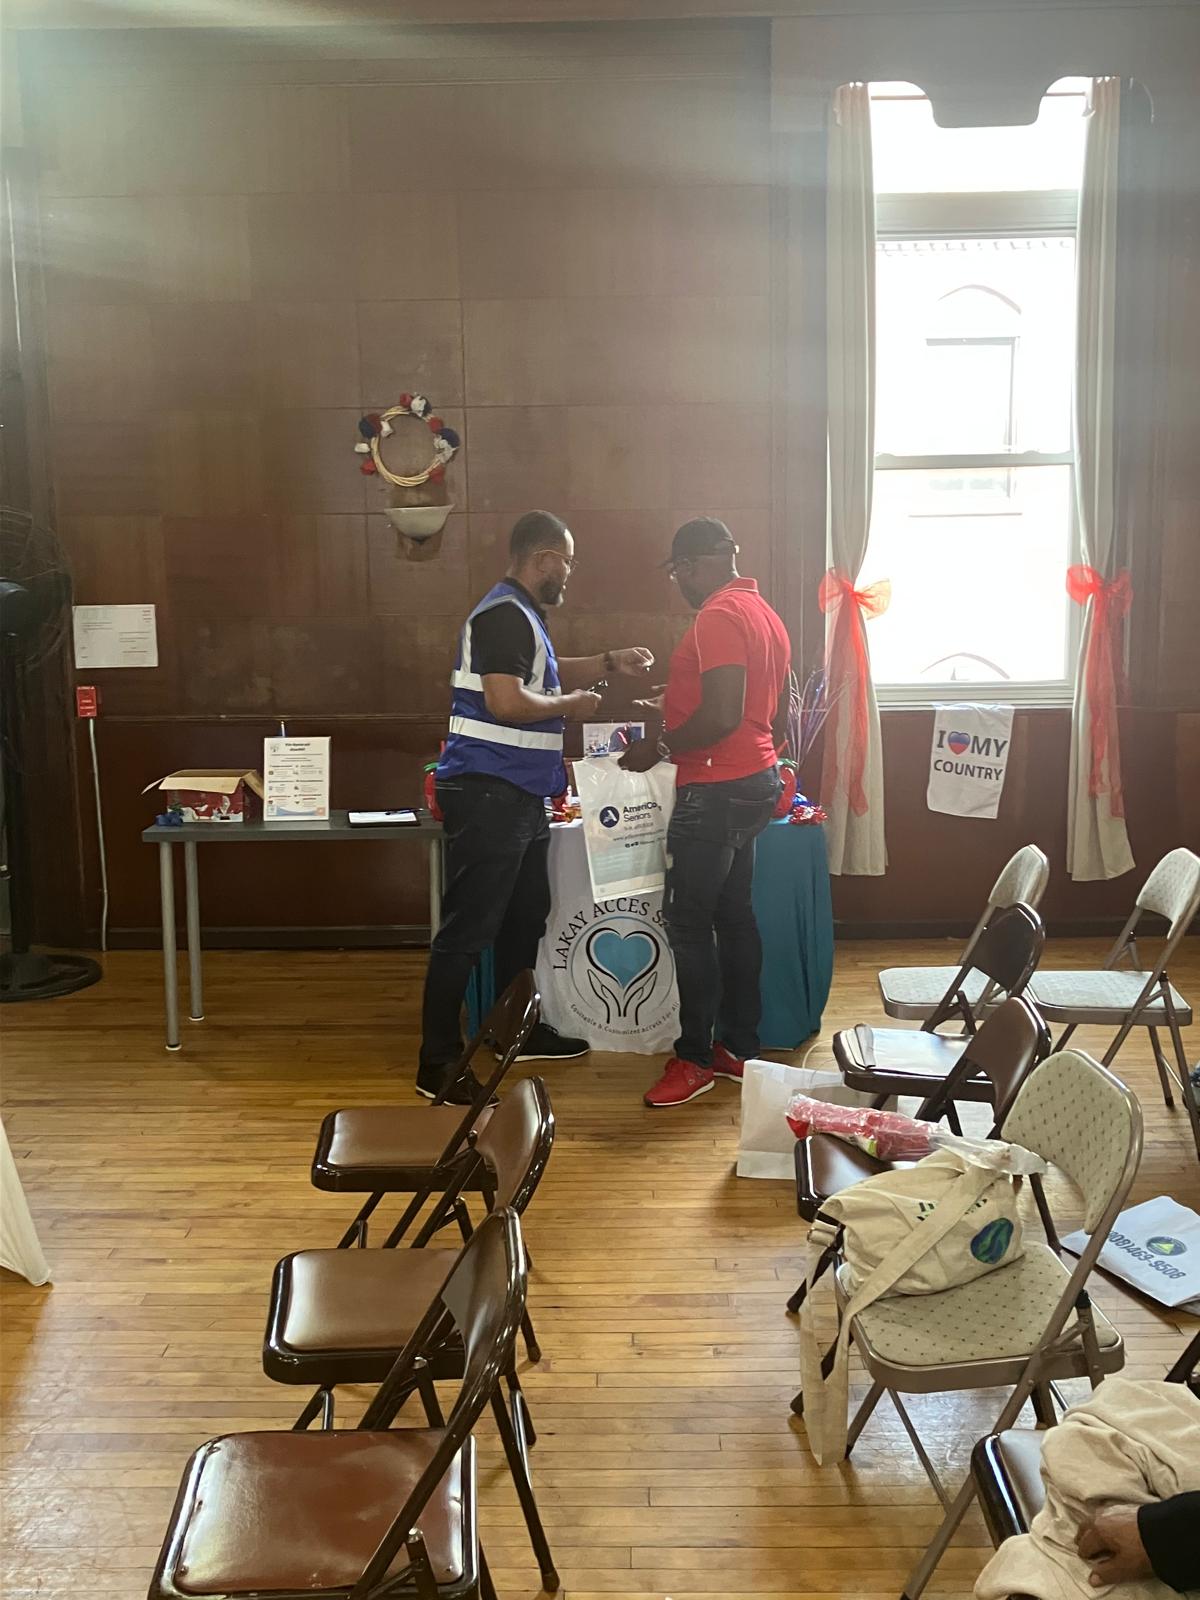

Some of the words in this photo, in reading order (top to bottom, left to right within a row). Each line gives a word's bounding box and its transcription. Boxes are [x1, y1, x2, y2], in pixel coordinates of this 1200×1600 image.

[936, 730, 946, 749] I
[970, 735, 1008, 758] MY
[933, 759, 1003, 781] COUNTRY
[623, 812, 652, 823] Seniors
[553, 910, 589, 970] LAKAY
[593, 897, 650, 918] ACCES
